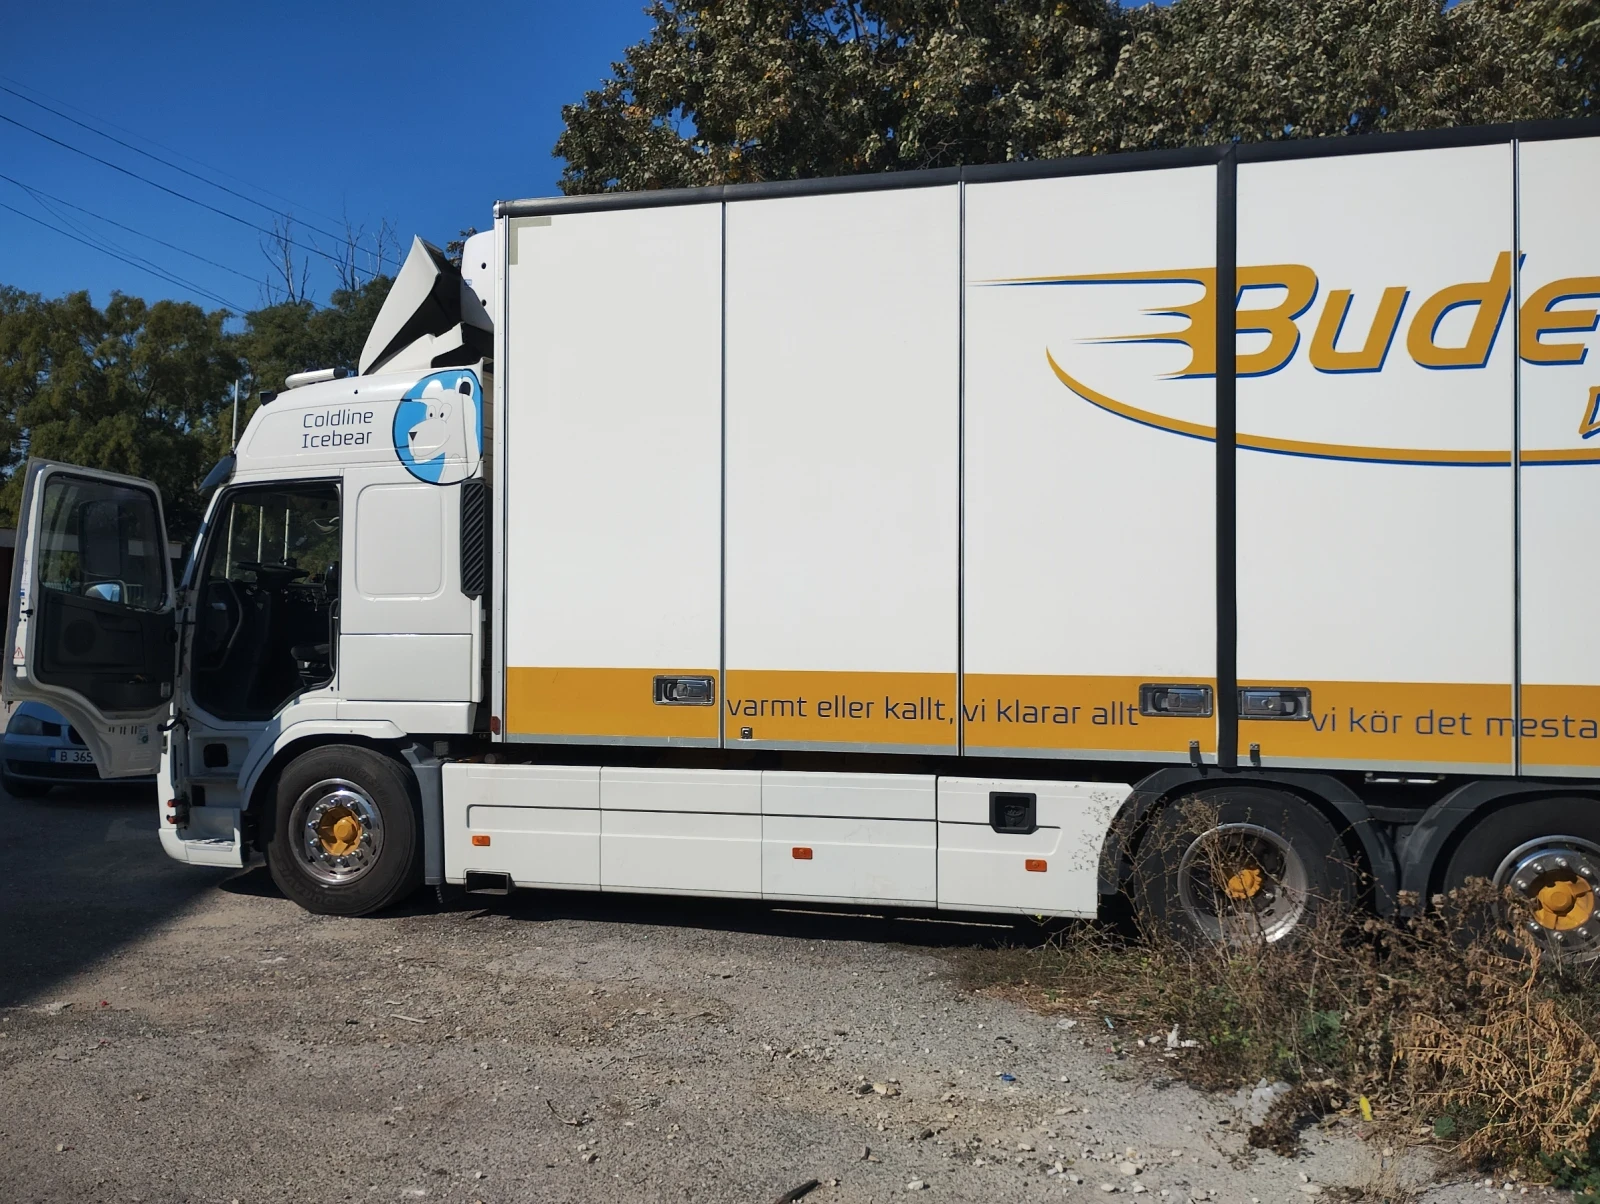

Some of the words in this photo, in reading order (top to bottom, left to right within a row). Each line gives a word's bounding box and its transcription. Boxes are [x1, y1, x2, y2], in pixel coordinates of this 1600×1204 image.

[302, 408, 374, 429] Coldline
[301, 430, 373, 449] Icebear
[726, 695, 808, 718] varmt
[816, 694, 875, 719] eller
[884, 695, 954, 725] kallt,
[962, 698, 986, 722] vi
[996, 698, 1082, 725] klarar
[1091, 700, 1139, 726] allt
[1310, 706, 1336, 732] vi
[1349, 706, 1403, 734] kör
[1415, 708, 1473, 737] det
[1486, 714, 1598, 739] mesta
[60, 750, 68, 762] B
